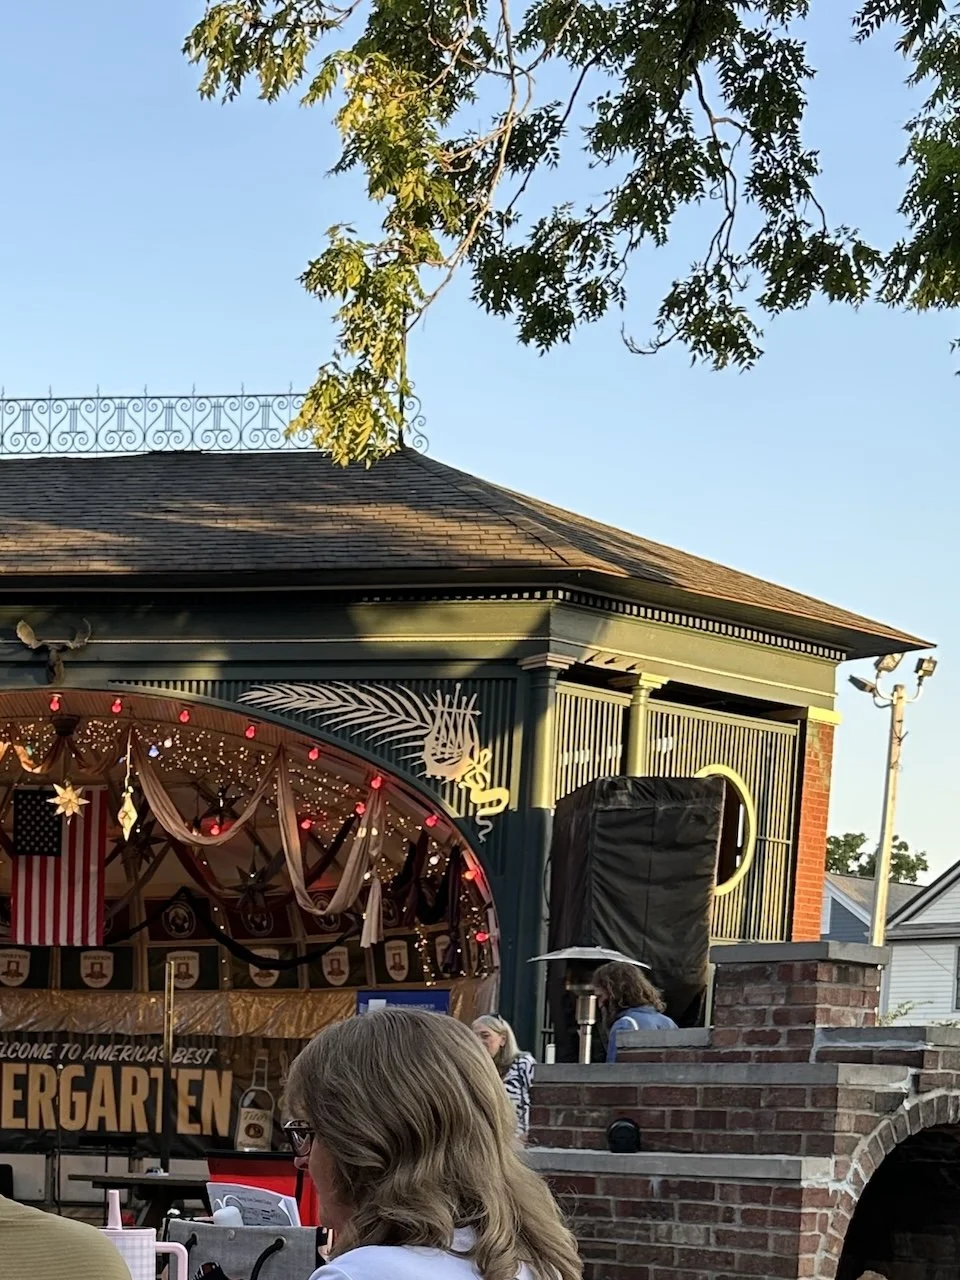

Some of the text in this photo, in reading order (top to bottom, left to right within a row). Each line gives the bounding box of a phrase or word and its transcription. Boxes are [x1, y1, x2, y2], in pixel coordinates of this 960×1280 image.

[59, 1043, 82, 1060] TO
[82, 1044, 165, 1062] AMERICA'S
[171, 1047, 217, 1064] BEST
